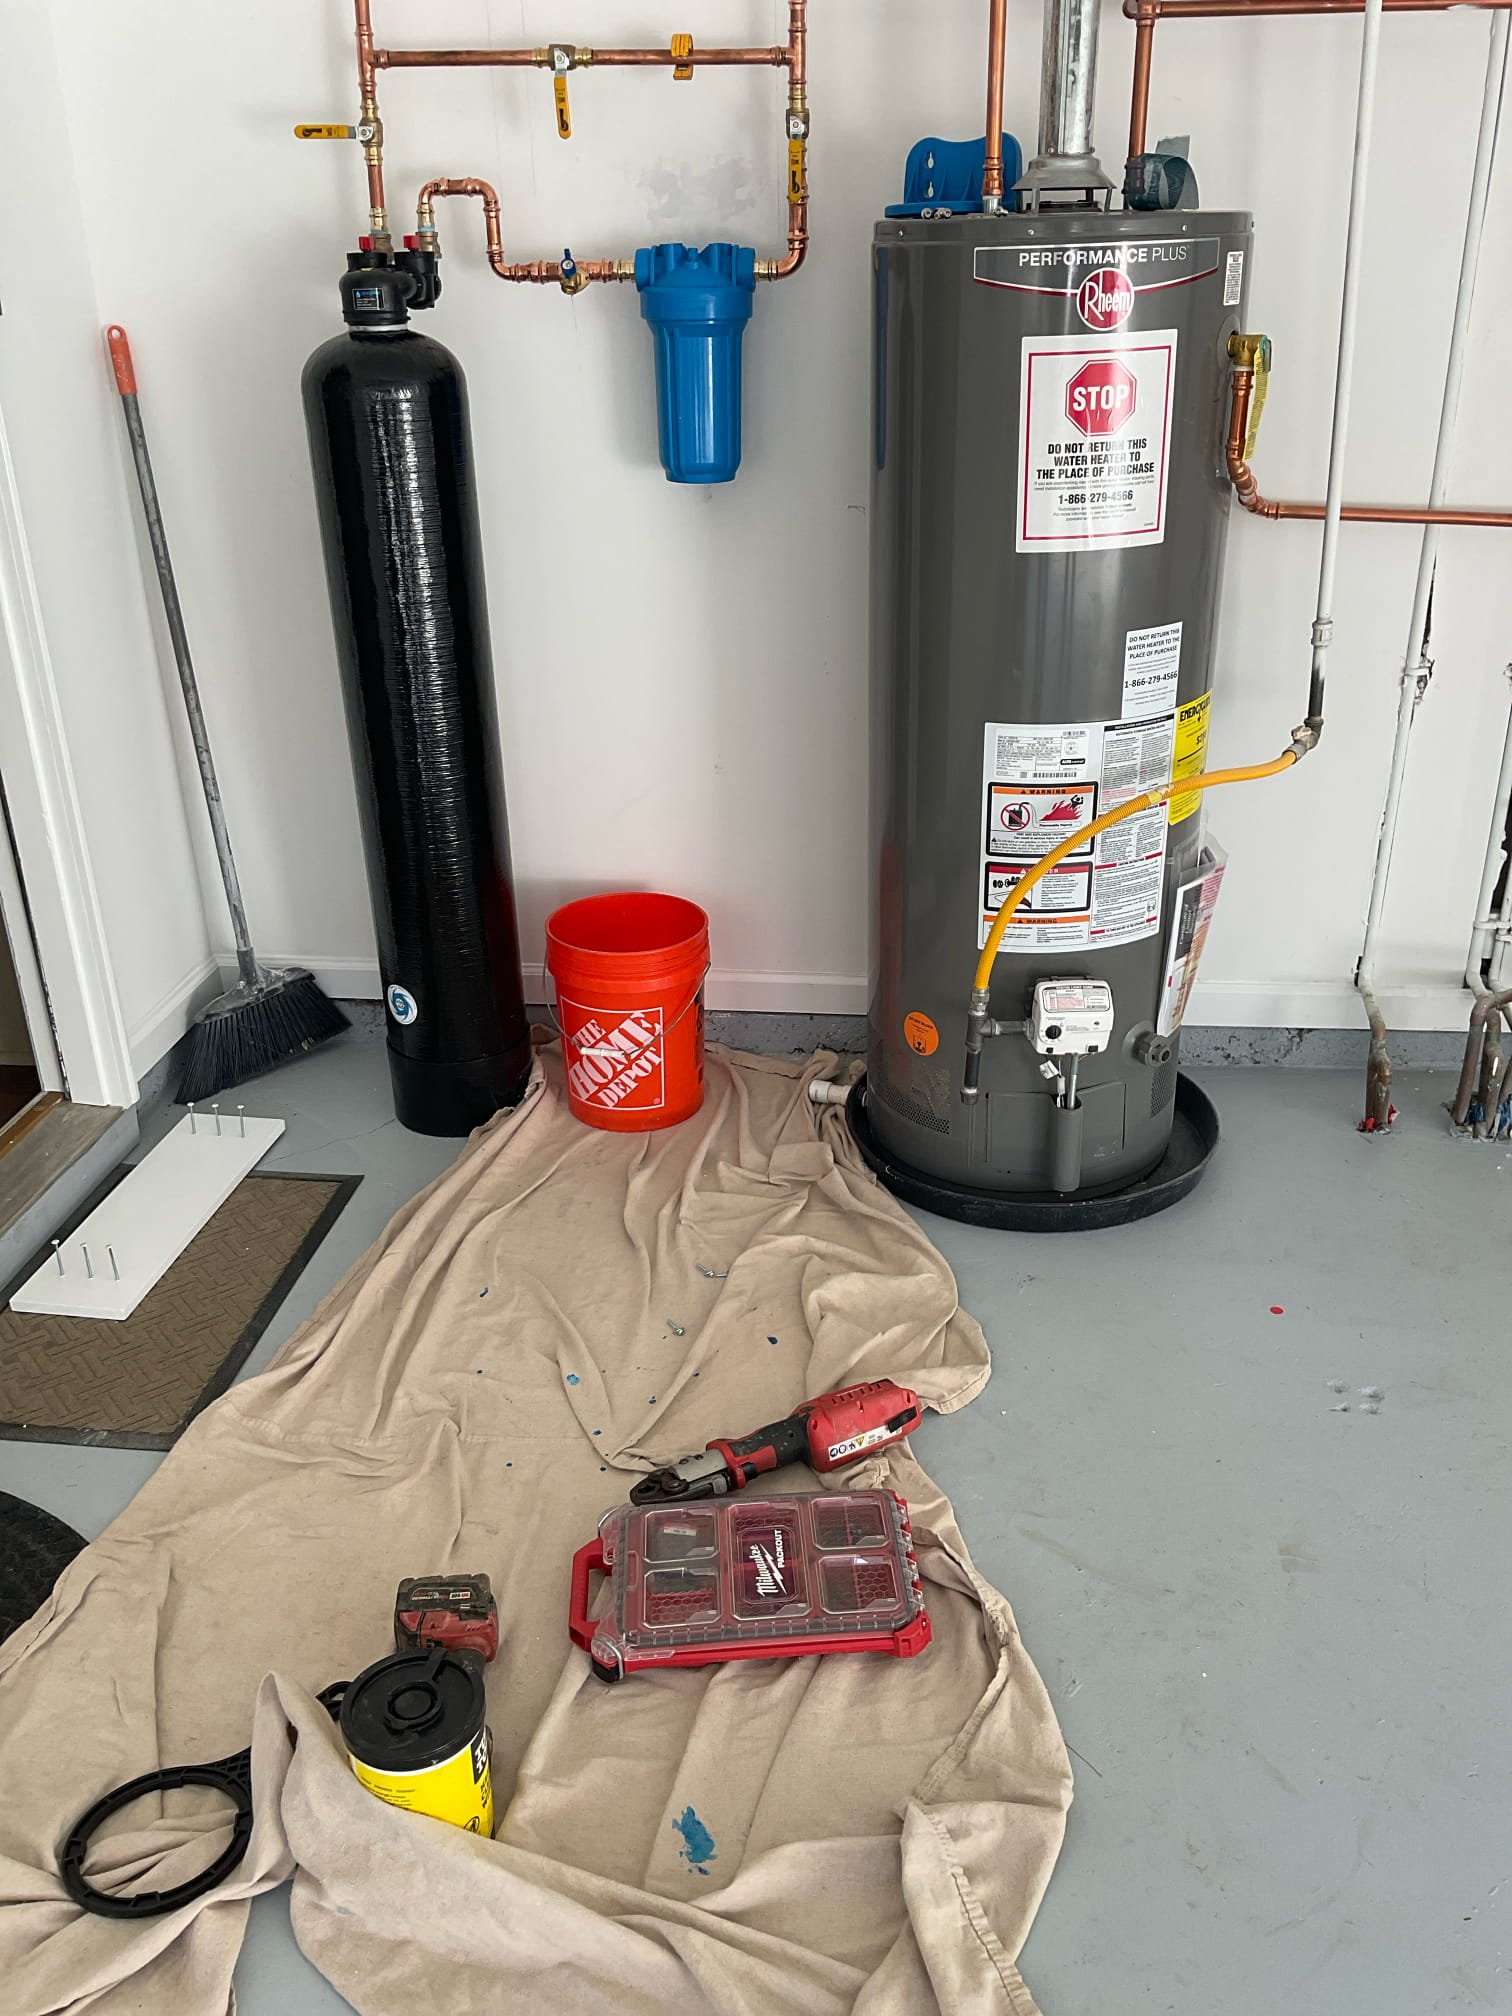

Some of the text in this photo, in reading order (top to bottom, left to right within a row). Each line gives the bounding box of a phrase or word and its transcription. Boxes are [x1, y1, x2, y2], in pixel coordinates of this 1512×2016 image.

[1019, 246, 1187, 267] PERFORMANCE PLUS
[1084, 270, 1130, 321] Rheem
[1072, 384, 1130, 412] STOP
[1047, 438, 1147, 454] DO NOT RETURN THIS
[1036, 462, 1155, 480] THE PLACE OF PURCHASE
[1053, 451, 1141, 467] WATER HEATER TO
[1127, 643, 1146, 652] WATER
[1138, 634, 1150, 642] NOT
[1150, 631, 1170, 640] RETURN
[1129, 651, 1146, 660] PLACE
[1153, 645, 1178, 656] PURCHASE
[571, 1018, 607, 1048] THE
[568, 1012, 663, 1101] HOME
[597, 1046, 663, 1108] DEPOT
[774, 1529, 786, 1569] PACKOUT
[748, 1544, 779, 1598] Milwaukee
